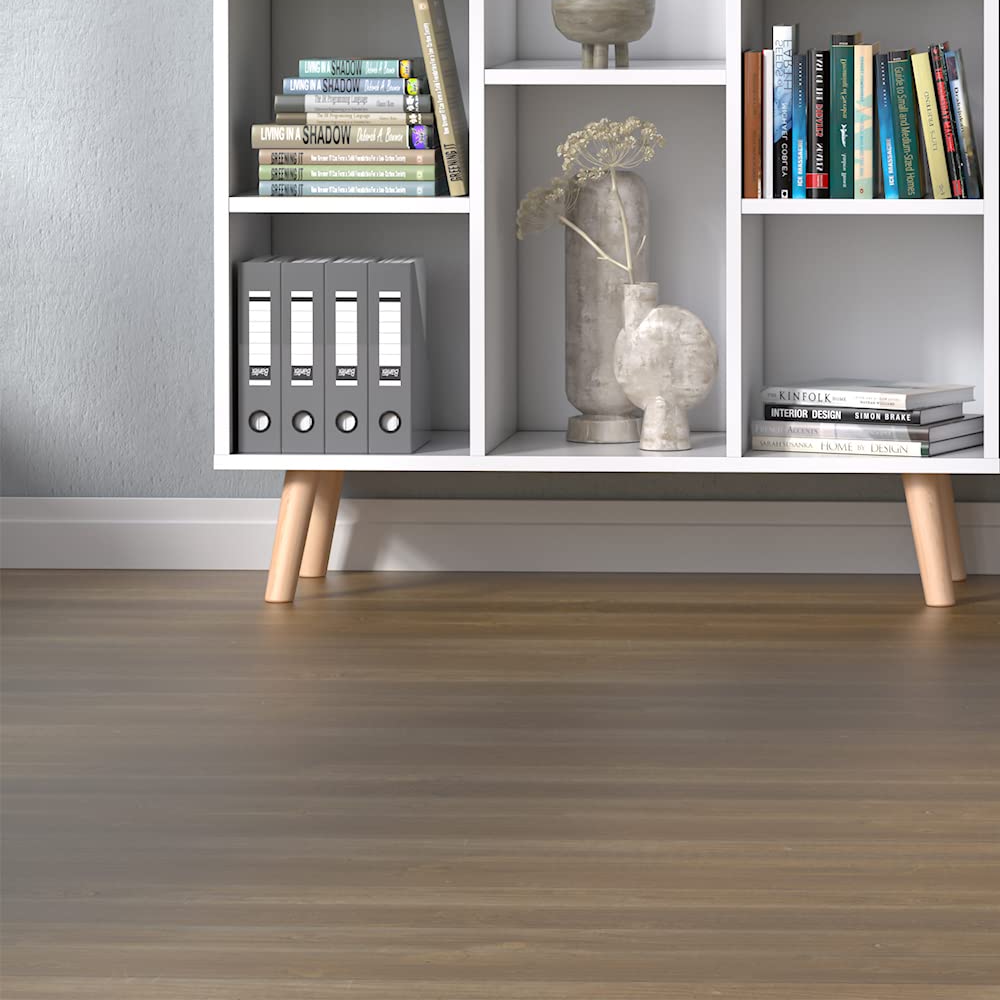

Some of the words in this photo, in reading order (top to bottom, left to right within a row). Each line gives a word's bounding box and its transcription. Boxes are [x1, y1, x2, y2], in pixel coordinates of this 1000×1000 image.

[895, 67, 906, 86] Guide
[290, 80, 310, 91] LIVING
[310, 80, 316, 90] IN
[316, 80, 322, 90] A
[322, 79, 361, 93] SHADOW
[897, 95, 910, 113] Small
[900, 113, 911, 127] and
[261, 128, 284, 140] LIVING
[286, 128, 294, 140] IN
[295, 128, 302, 140] A
[302, 125, 352, 144] SHADOW
[901, 127, 915, 171] Medium-Sized
[445, 150, 463, 182] GREENING
[905, 172, 916, 196] Homes
[771, 408, 808, 419] INTERIOR
[812, 409, 842, 420] DESIGN
[855, 412, 881, 421] SIMON
[885, 413, 911, 422] BRAKE
[821, 442, 853, 452] HOME
[870, 442, 908, 453] DESIGN
